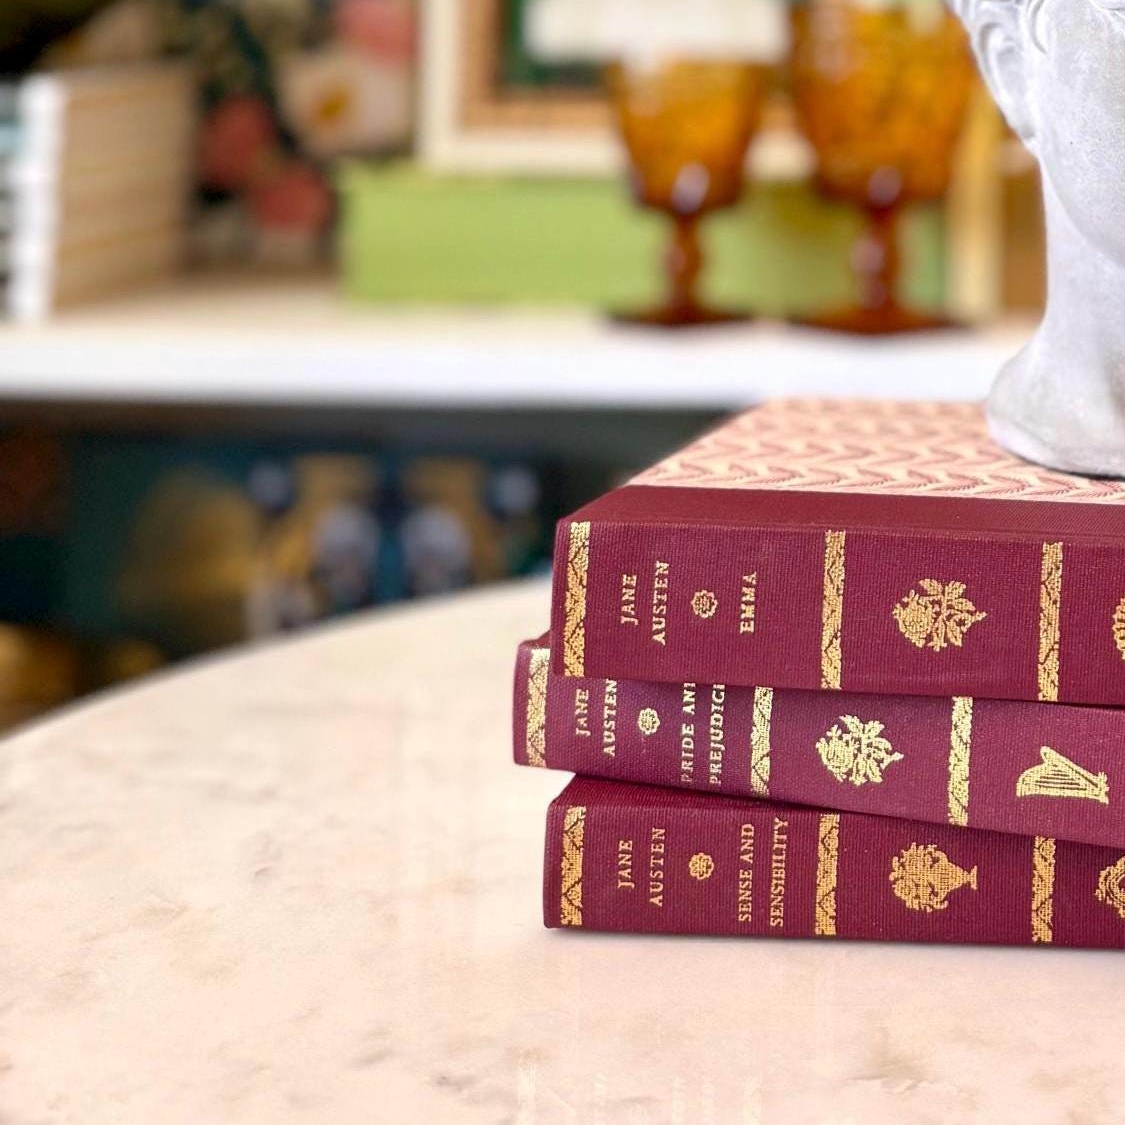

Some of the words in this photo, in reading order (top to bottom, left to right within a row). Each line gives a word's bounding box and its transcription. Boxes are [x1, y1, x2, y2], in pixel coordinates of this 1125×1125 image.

[620, 574, 639, 626] JANE
[652, 560, 670, 646] AUSTEN
[739, 571, 757, 634] EMMA
[574, 688, 591, 737] JANE
[603, 678, 618, 757] AUSTEN
[681, 723, 695, 782] PRIDE
[617, 840, 635, 889] JANE
[649, 827, 666, 907] AUSTEN
[739, 823, 755, 864] AND
[769, 817, 789, 927] SENSIBILITY
[738, 869, 753, 922] SENSE
